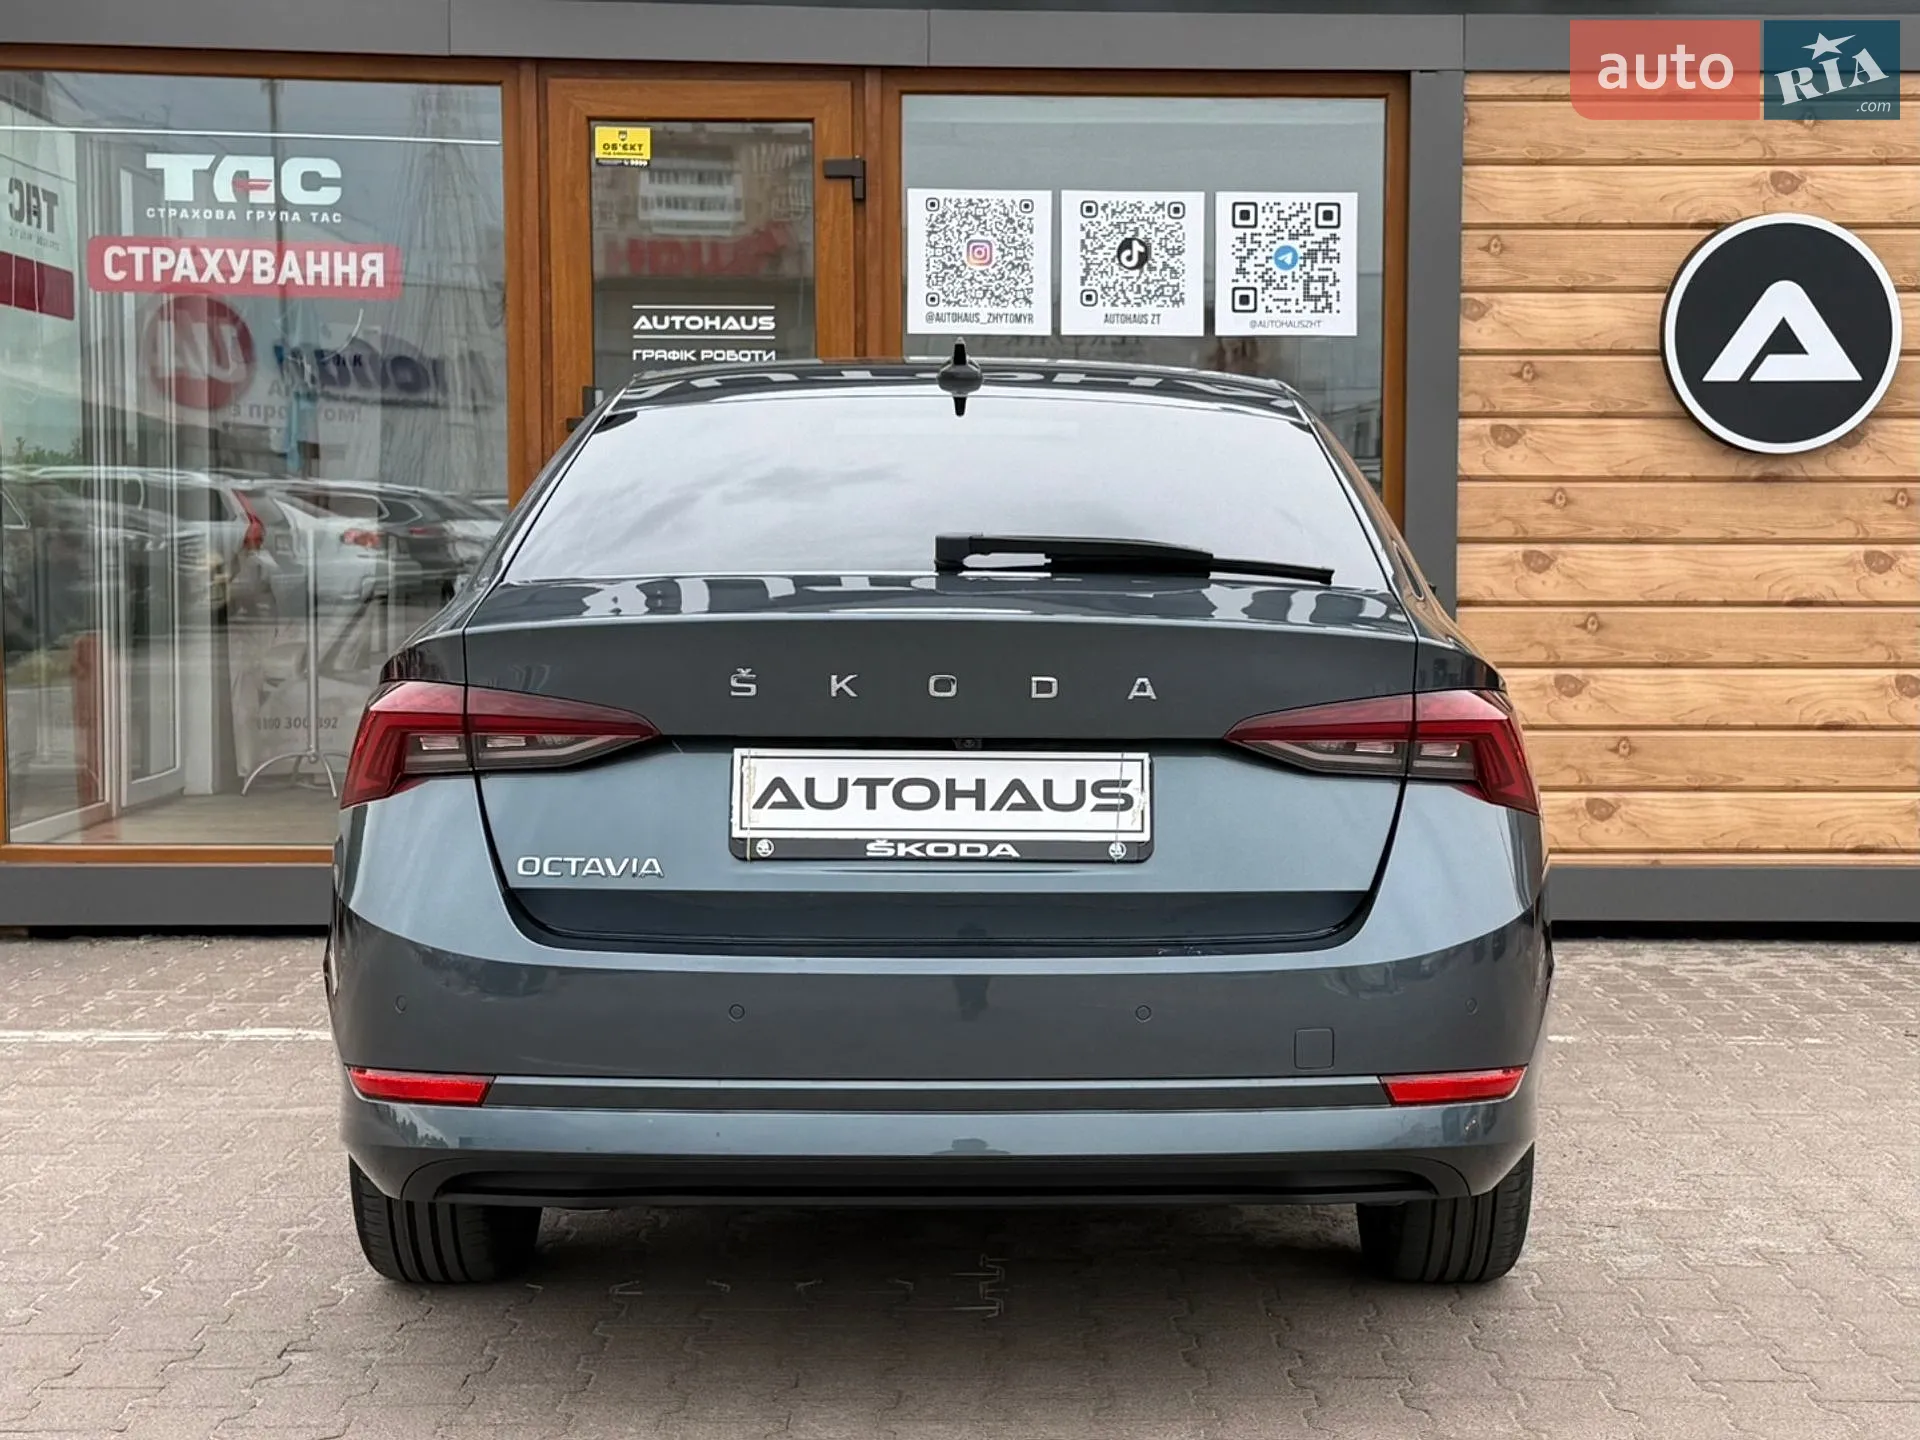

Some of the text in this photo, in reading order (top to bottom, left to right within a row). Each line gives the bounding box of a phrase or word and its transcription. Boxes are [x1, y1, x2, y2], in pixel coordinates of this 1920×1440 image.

[145, 207, 342, 224] СТРАХОВА ГРУПА ТАС
[102, 245, 385, 288] СТРАХУВАННЯ
[632, 315, 776, 331] AUTOHAUS
[925, 310, 1035, 325] @AUTOHAUS_ZHYTOMYR
[1103, 312, 1162, 326] AUTOHAUS ZT
[632, 349, 776, 363] ГРАФІК РОБОТИ
[730, 667, 1158, 701] ŠKODA
[752, 775, 1135, 813] AUTOHAUS
[866, 840, 1022, 858] ŠKODA
[516, 856, 665, 879] OCTAVIA
